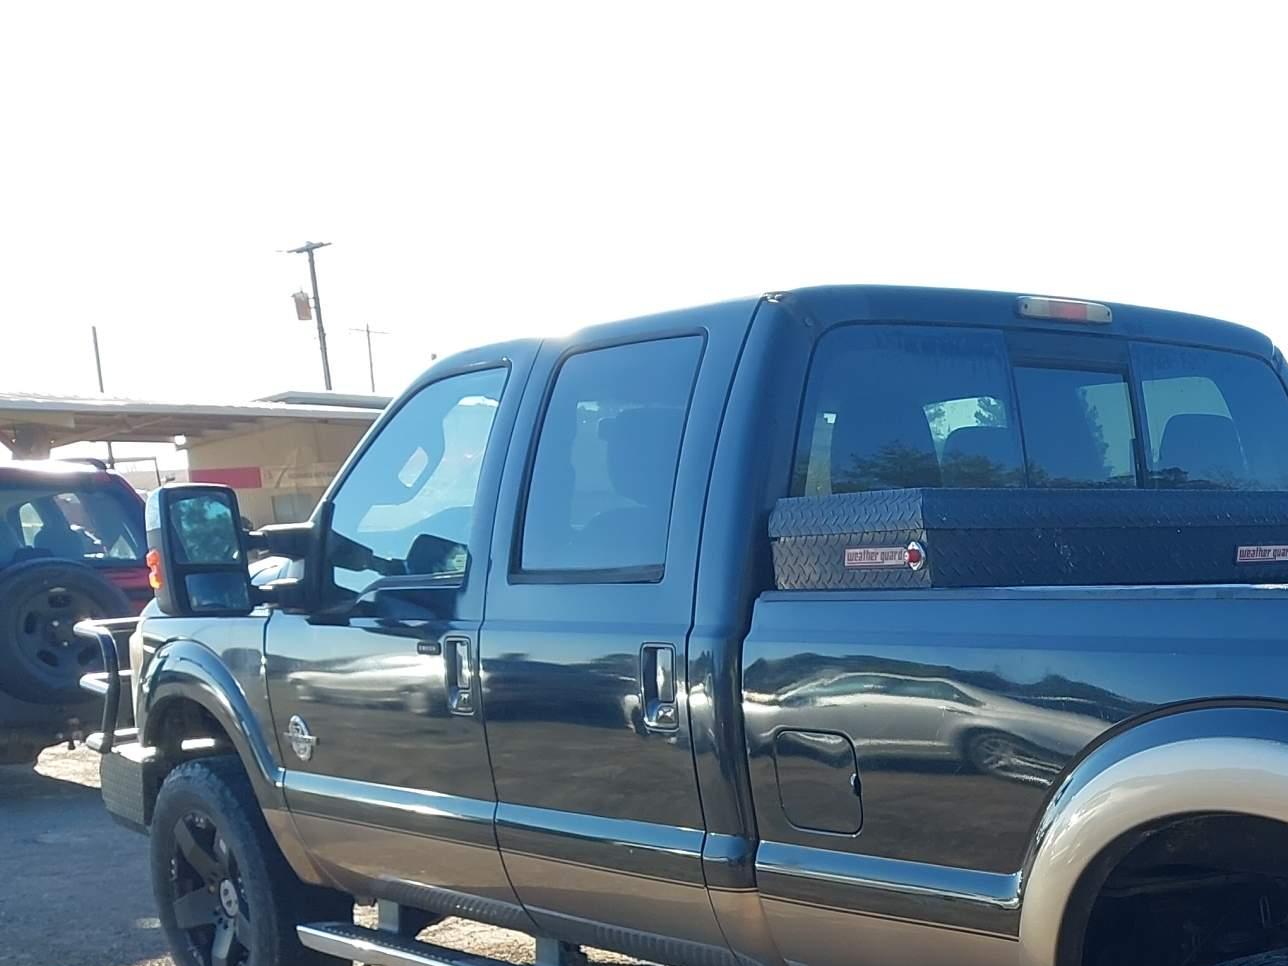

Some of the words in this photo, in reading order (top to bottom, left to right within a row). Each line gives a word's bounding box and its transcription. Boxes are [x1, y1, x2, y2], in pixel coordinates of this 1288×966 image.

[847, 549, 879, 561] weather
[880, 549, 903, 562] guard
[1240, 547, 1271, 558] weather
